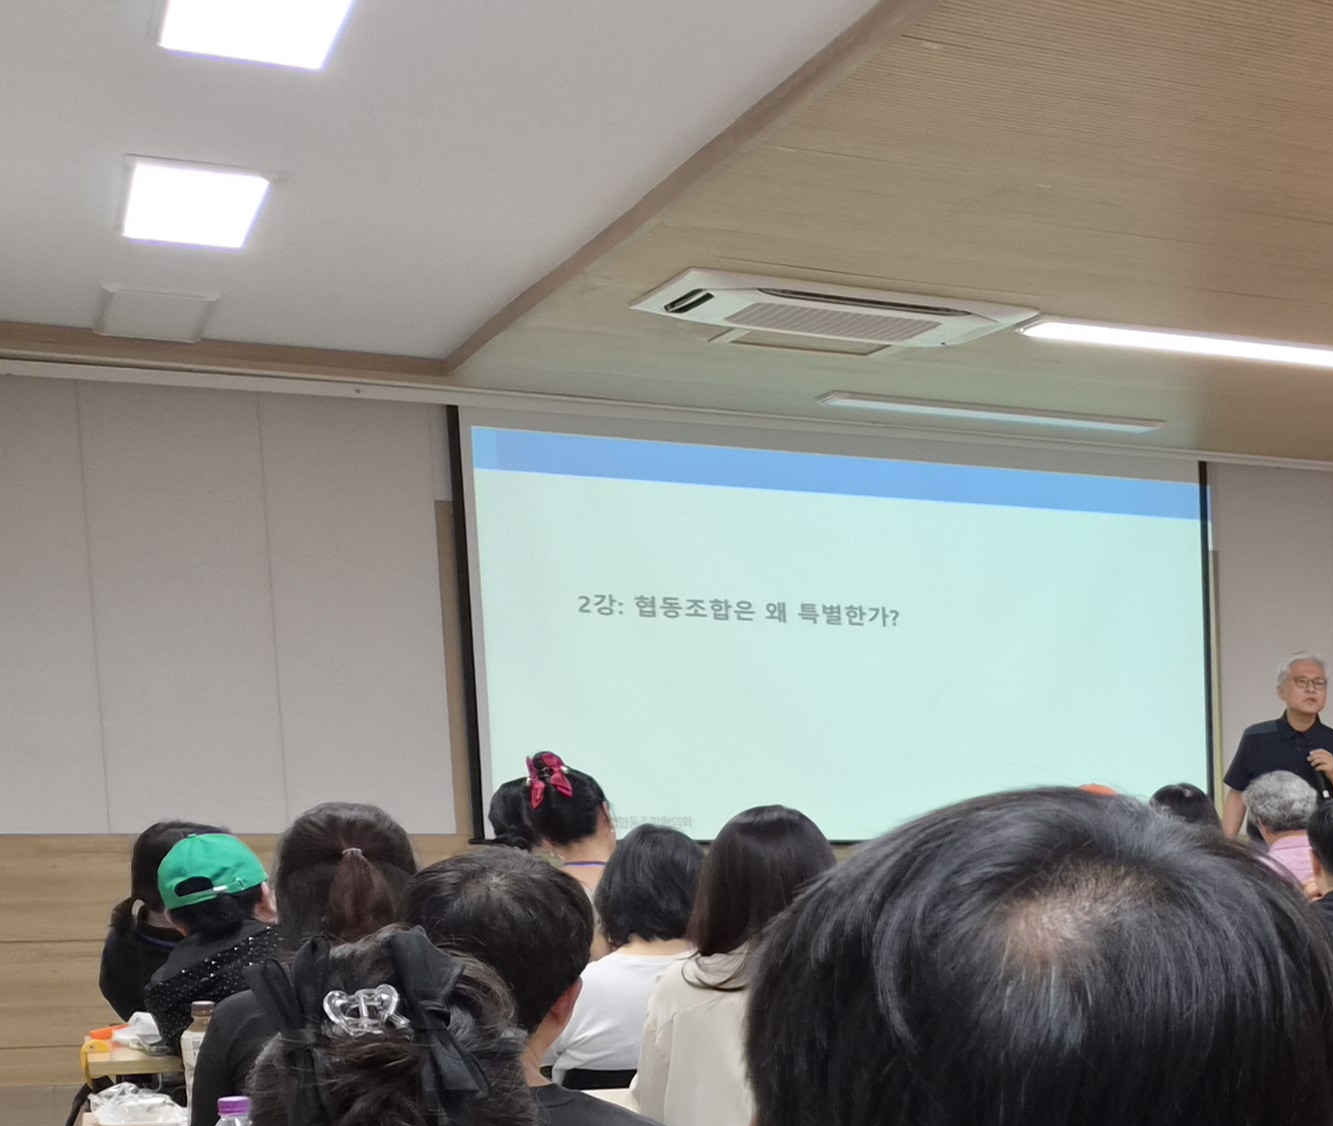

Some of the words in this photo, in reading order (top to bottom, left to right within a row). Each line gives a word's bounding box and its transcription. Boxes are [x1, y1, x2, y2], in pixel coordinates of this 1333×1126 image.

[578, 594, 624, 616] 2강:
[634, 594, 756, 622] 협동조합은
[765, 602, 787, 623] 왜
[797, 602, 900, 627] 특별한가?
